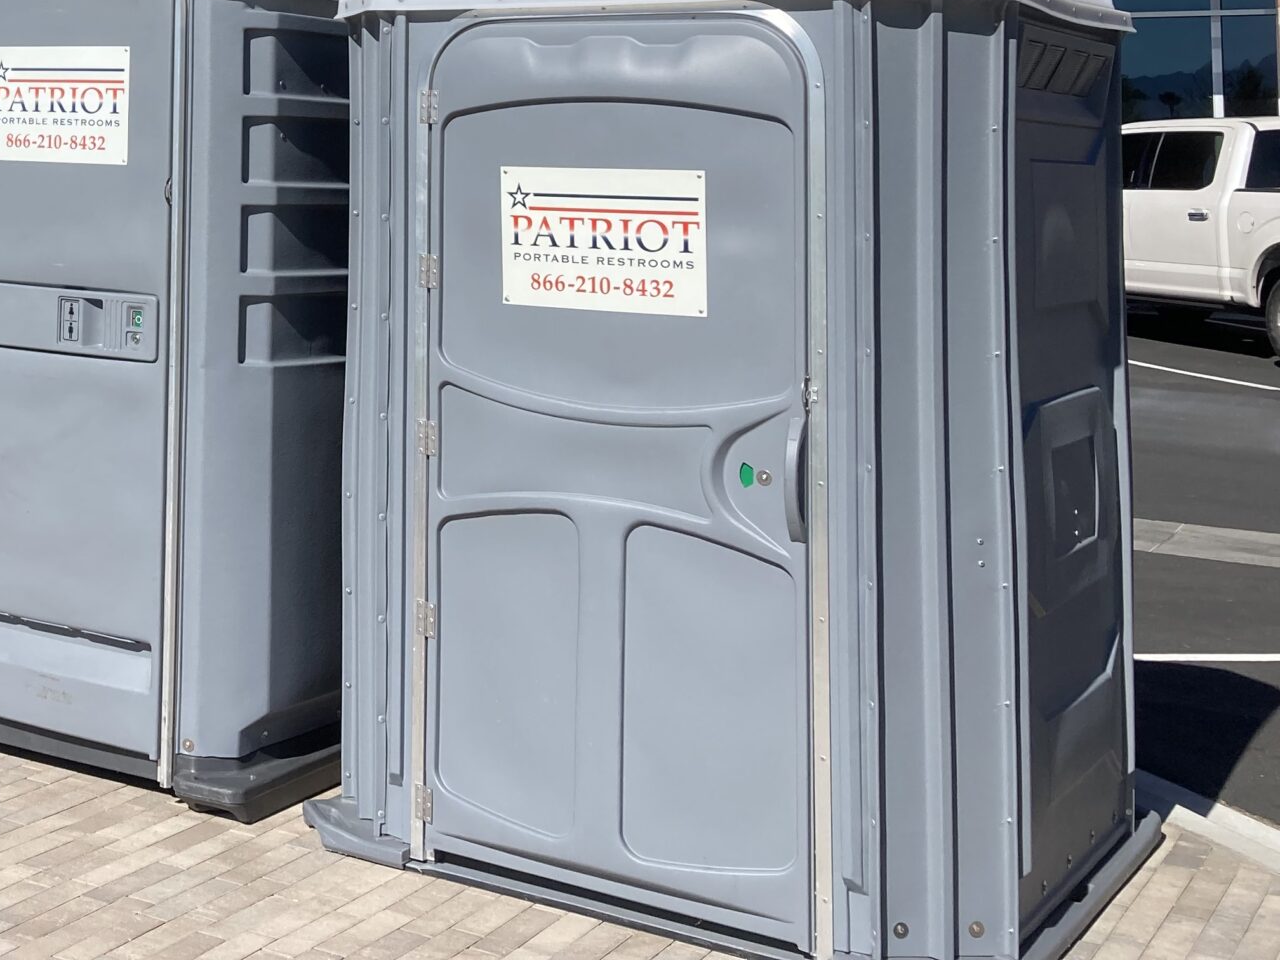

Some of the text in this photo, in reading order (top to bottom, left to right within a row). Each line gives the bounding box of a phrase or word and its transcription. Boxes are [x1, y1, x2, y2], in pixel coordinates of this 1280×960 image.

[52, 118, 121, 128] RESTROOMS
[6, 133, 106, 150] 866-210-8432
[509, 214, 701, 254] PATRIOT
[513, 252, 695, 270] PORTABLE RESTROOMS
[530, 272, 676, 299] 866-210-8432
